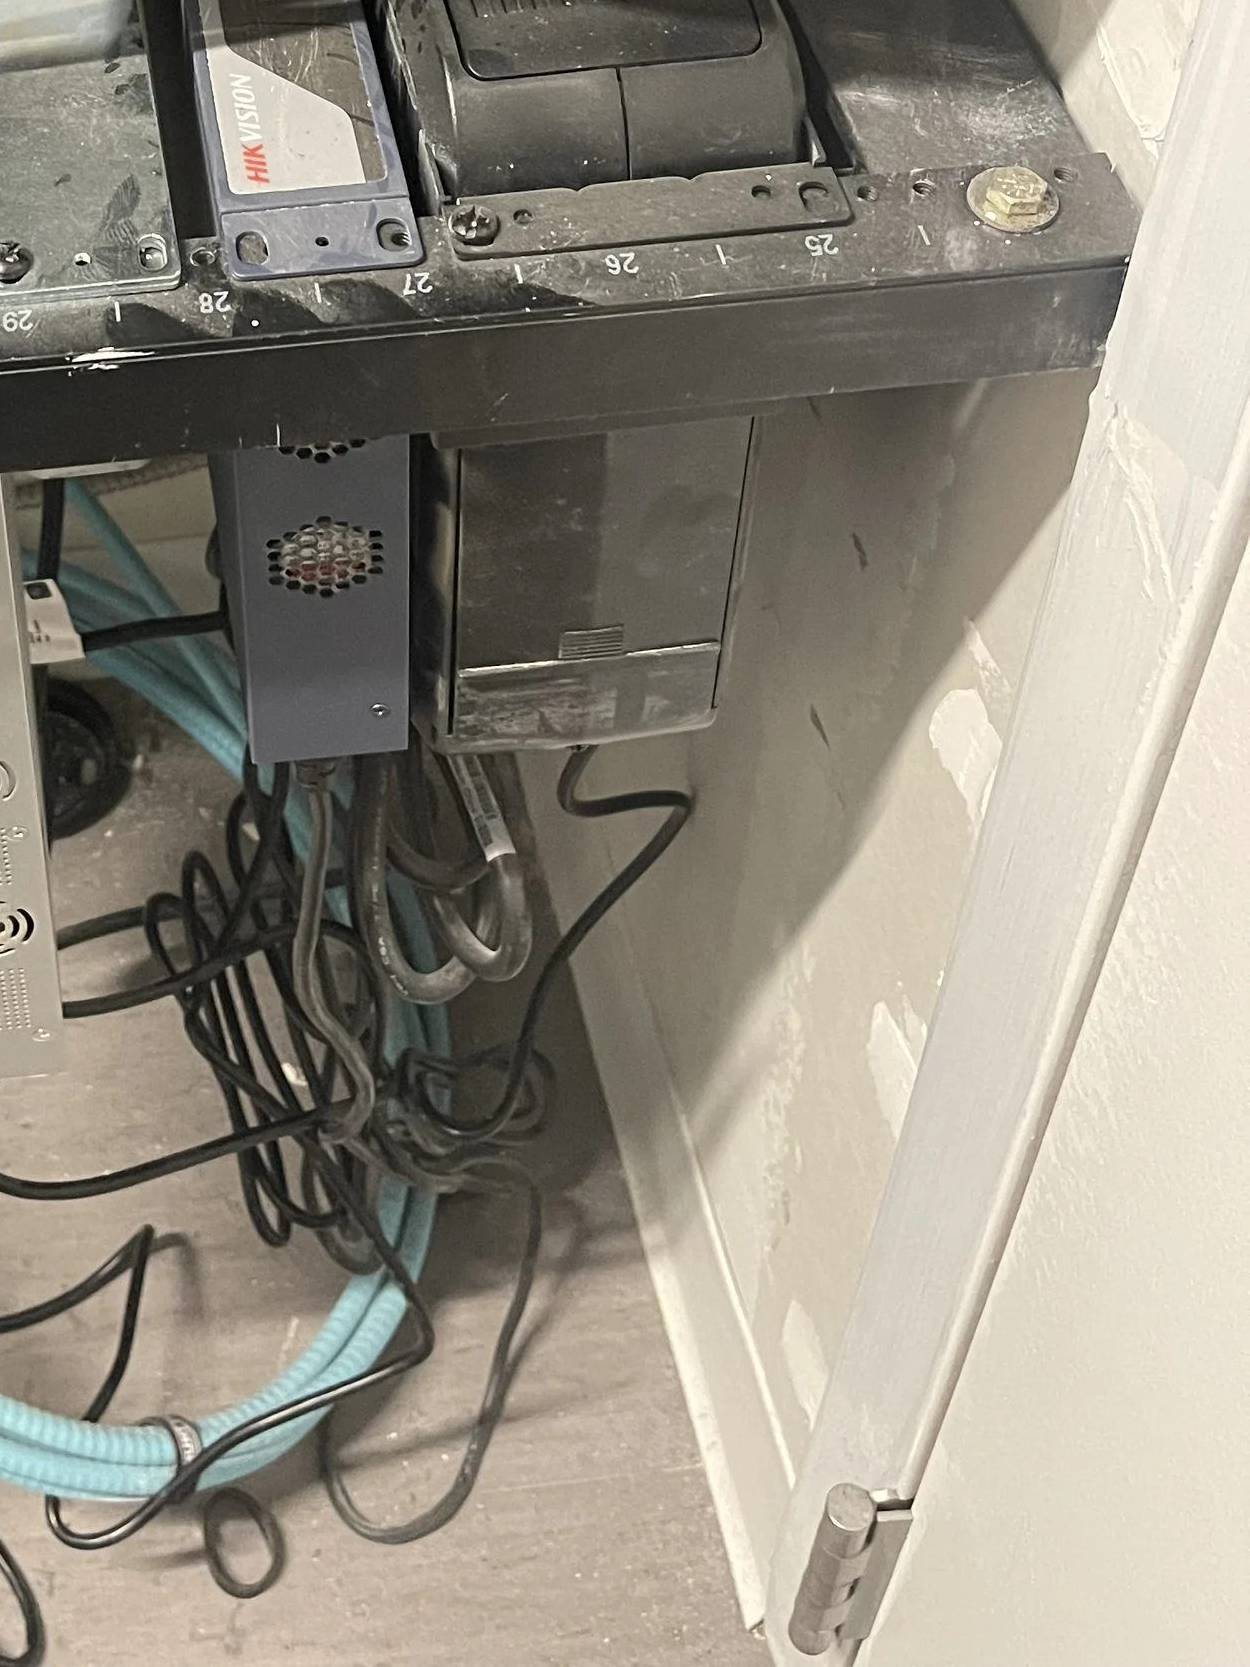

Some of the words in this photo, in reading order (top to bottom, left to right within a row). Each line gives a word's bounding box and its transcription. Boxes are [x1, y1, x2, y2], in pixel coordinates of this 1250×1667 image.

[229, 72, 271, 184] HIKVISION
[803, 233, 840, 258] 25
[604, 251, 640, 276] 26
[401, 271, 434, 297] 27
[198, 289, 232, 314] 28
[1, 308, 35, 333] 29
